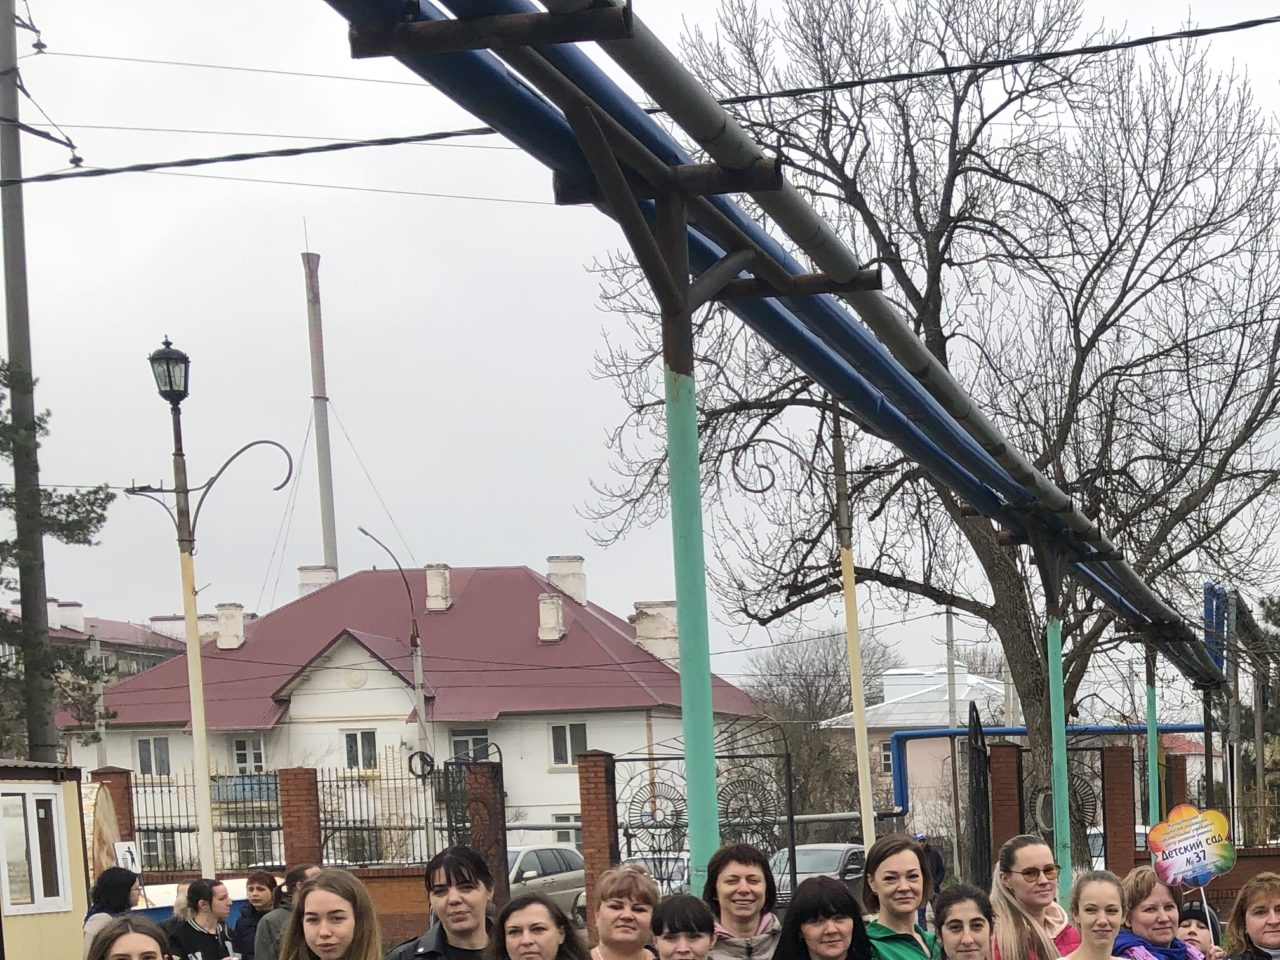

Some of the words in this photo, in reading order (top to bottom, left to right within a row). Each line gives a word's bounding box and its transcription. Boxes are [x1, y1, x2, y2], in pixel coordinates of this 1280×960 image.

[1161, 838, 1204, 861] Детский
[1205, 833, 1224, 846] сад
[1193, 849, 1207, 863] 37
